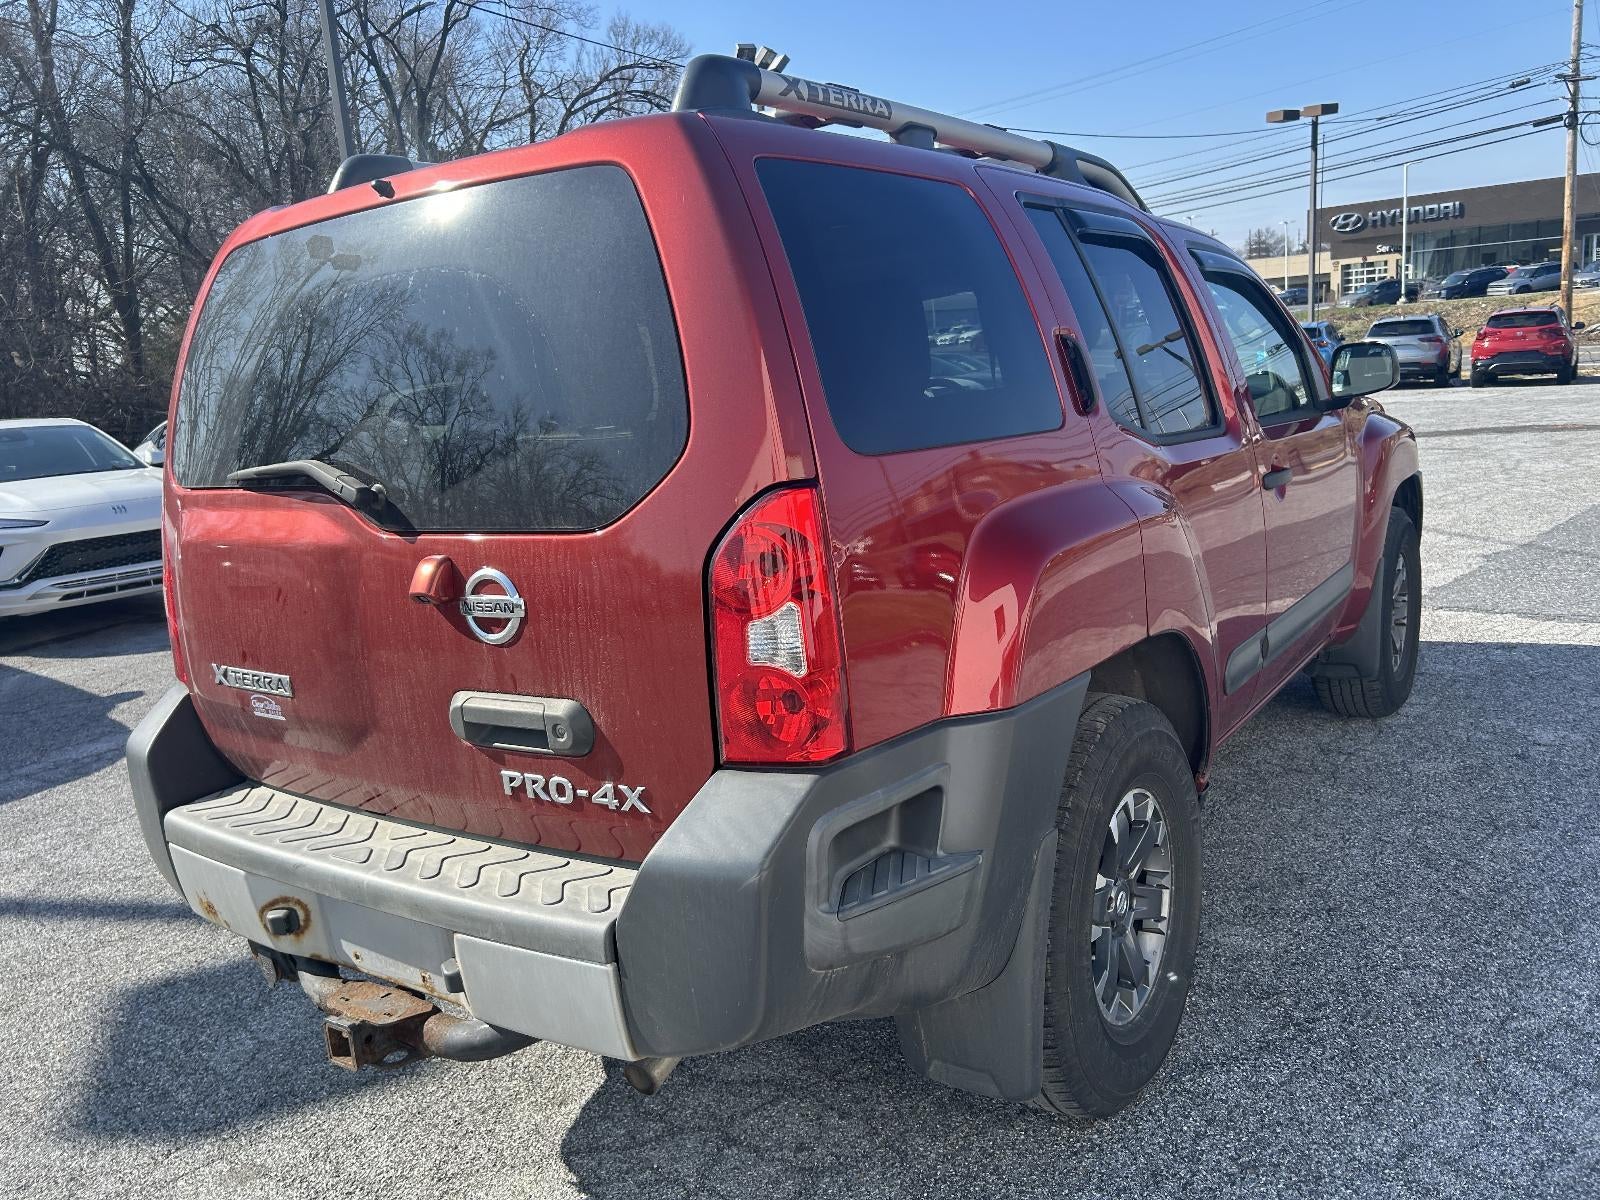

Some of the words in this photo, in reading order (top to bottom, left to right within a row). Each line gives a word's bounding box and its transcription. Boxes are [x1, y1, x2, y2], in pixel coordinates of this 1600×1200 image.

[778, 74, 893, 120] XTERRA
[1368, 201, 1461, 226] HYUNDAI
[463, 601, 515, 614] NISSAN
[212, 663, 292, 697] XTERRA
[501, 770, 652, 813] PRO-4X
